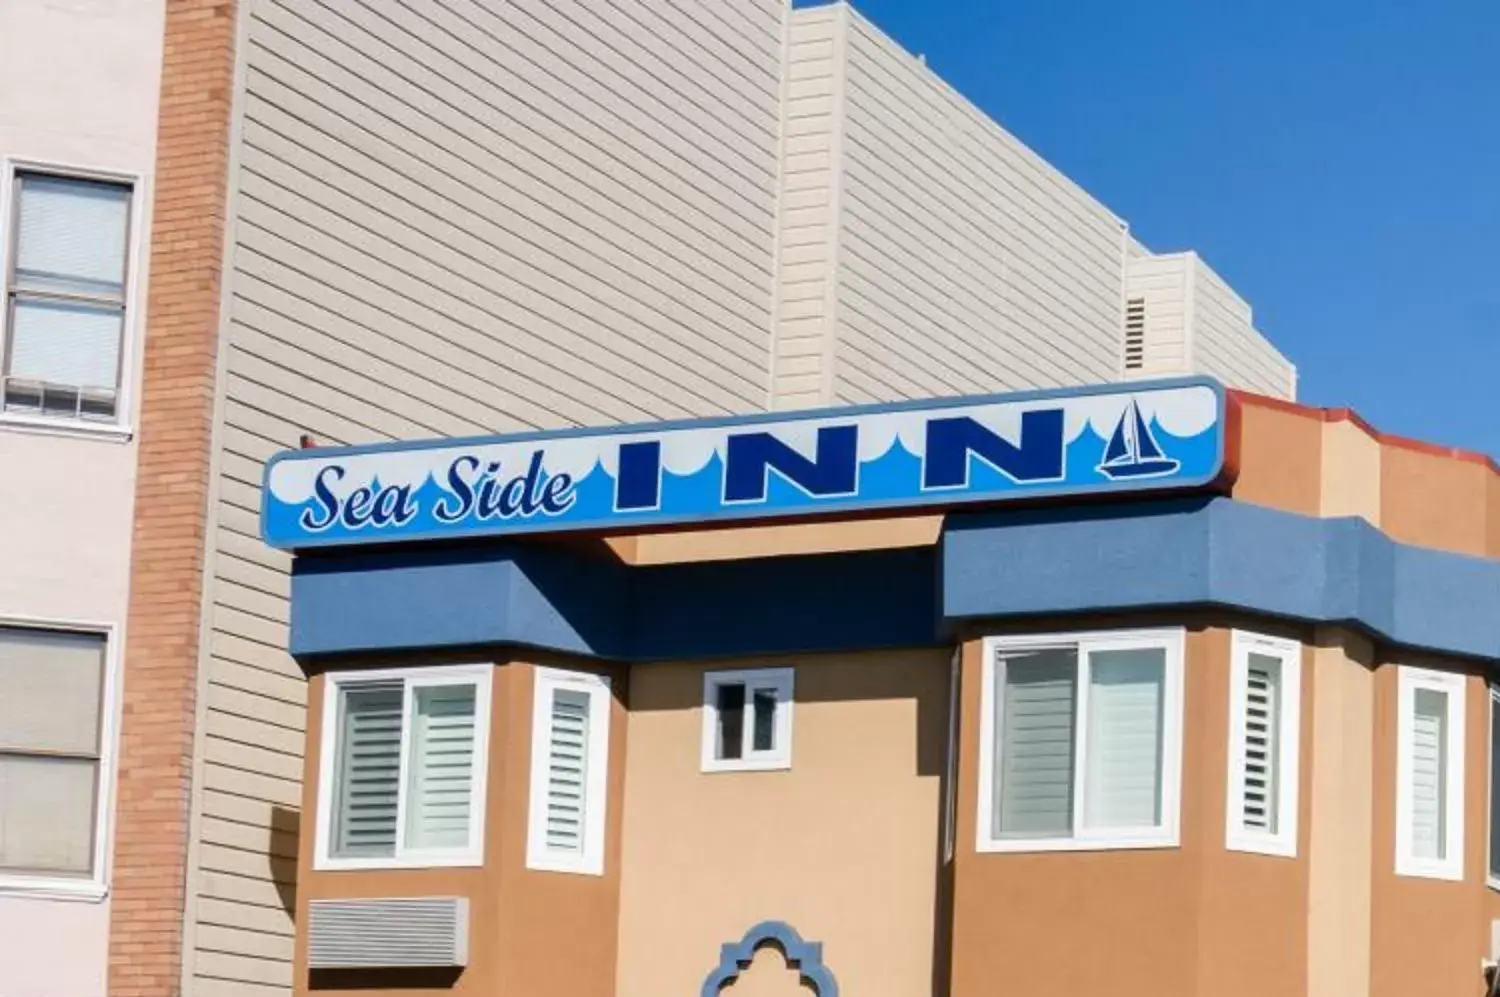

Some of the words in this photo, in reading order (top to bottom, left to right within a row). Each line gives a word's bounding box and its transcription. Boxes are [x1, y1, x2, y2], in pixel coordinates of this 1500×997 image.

[302, 464, 417, 529] Sea
[434, 449, 577, 521] Side
[614, 408, 1065, 511] INN
